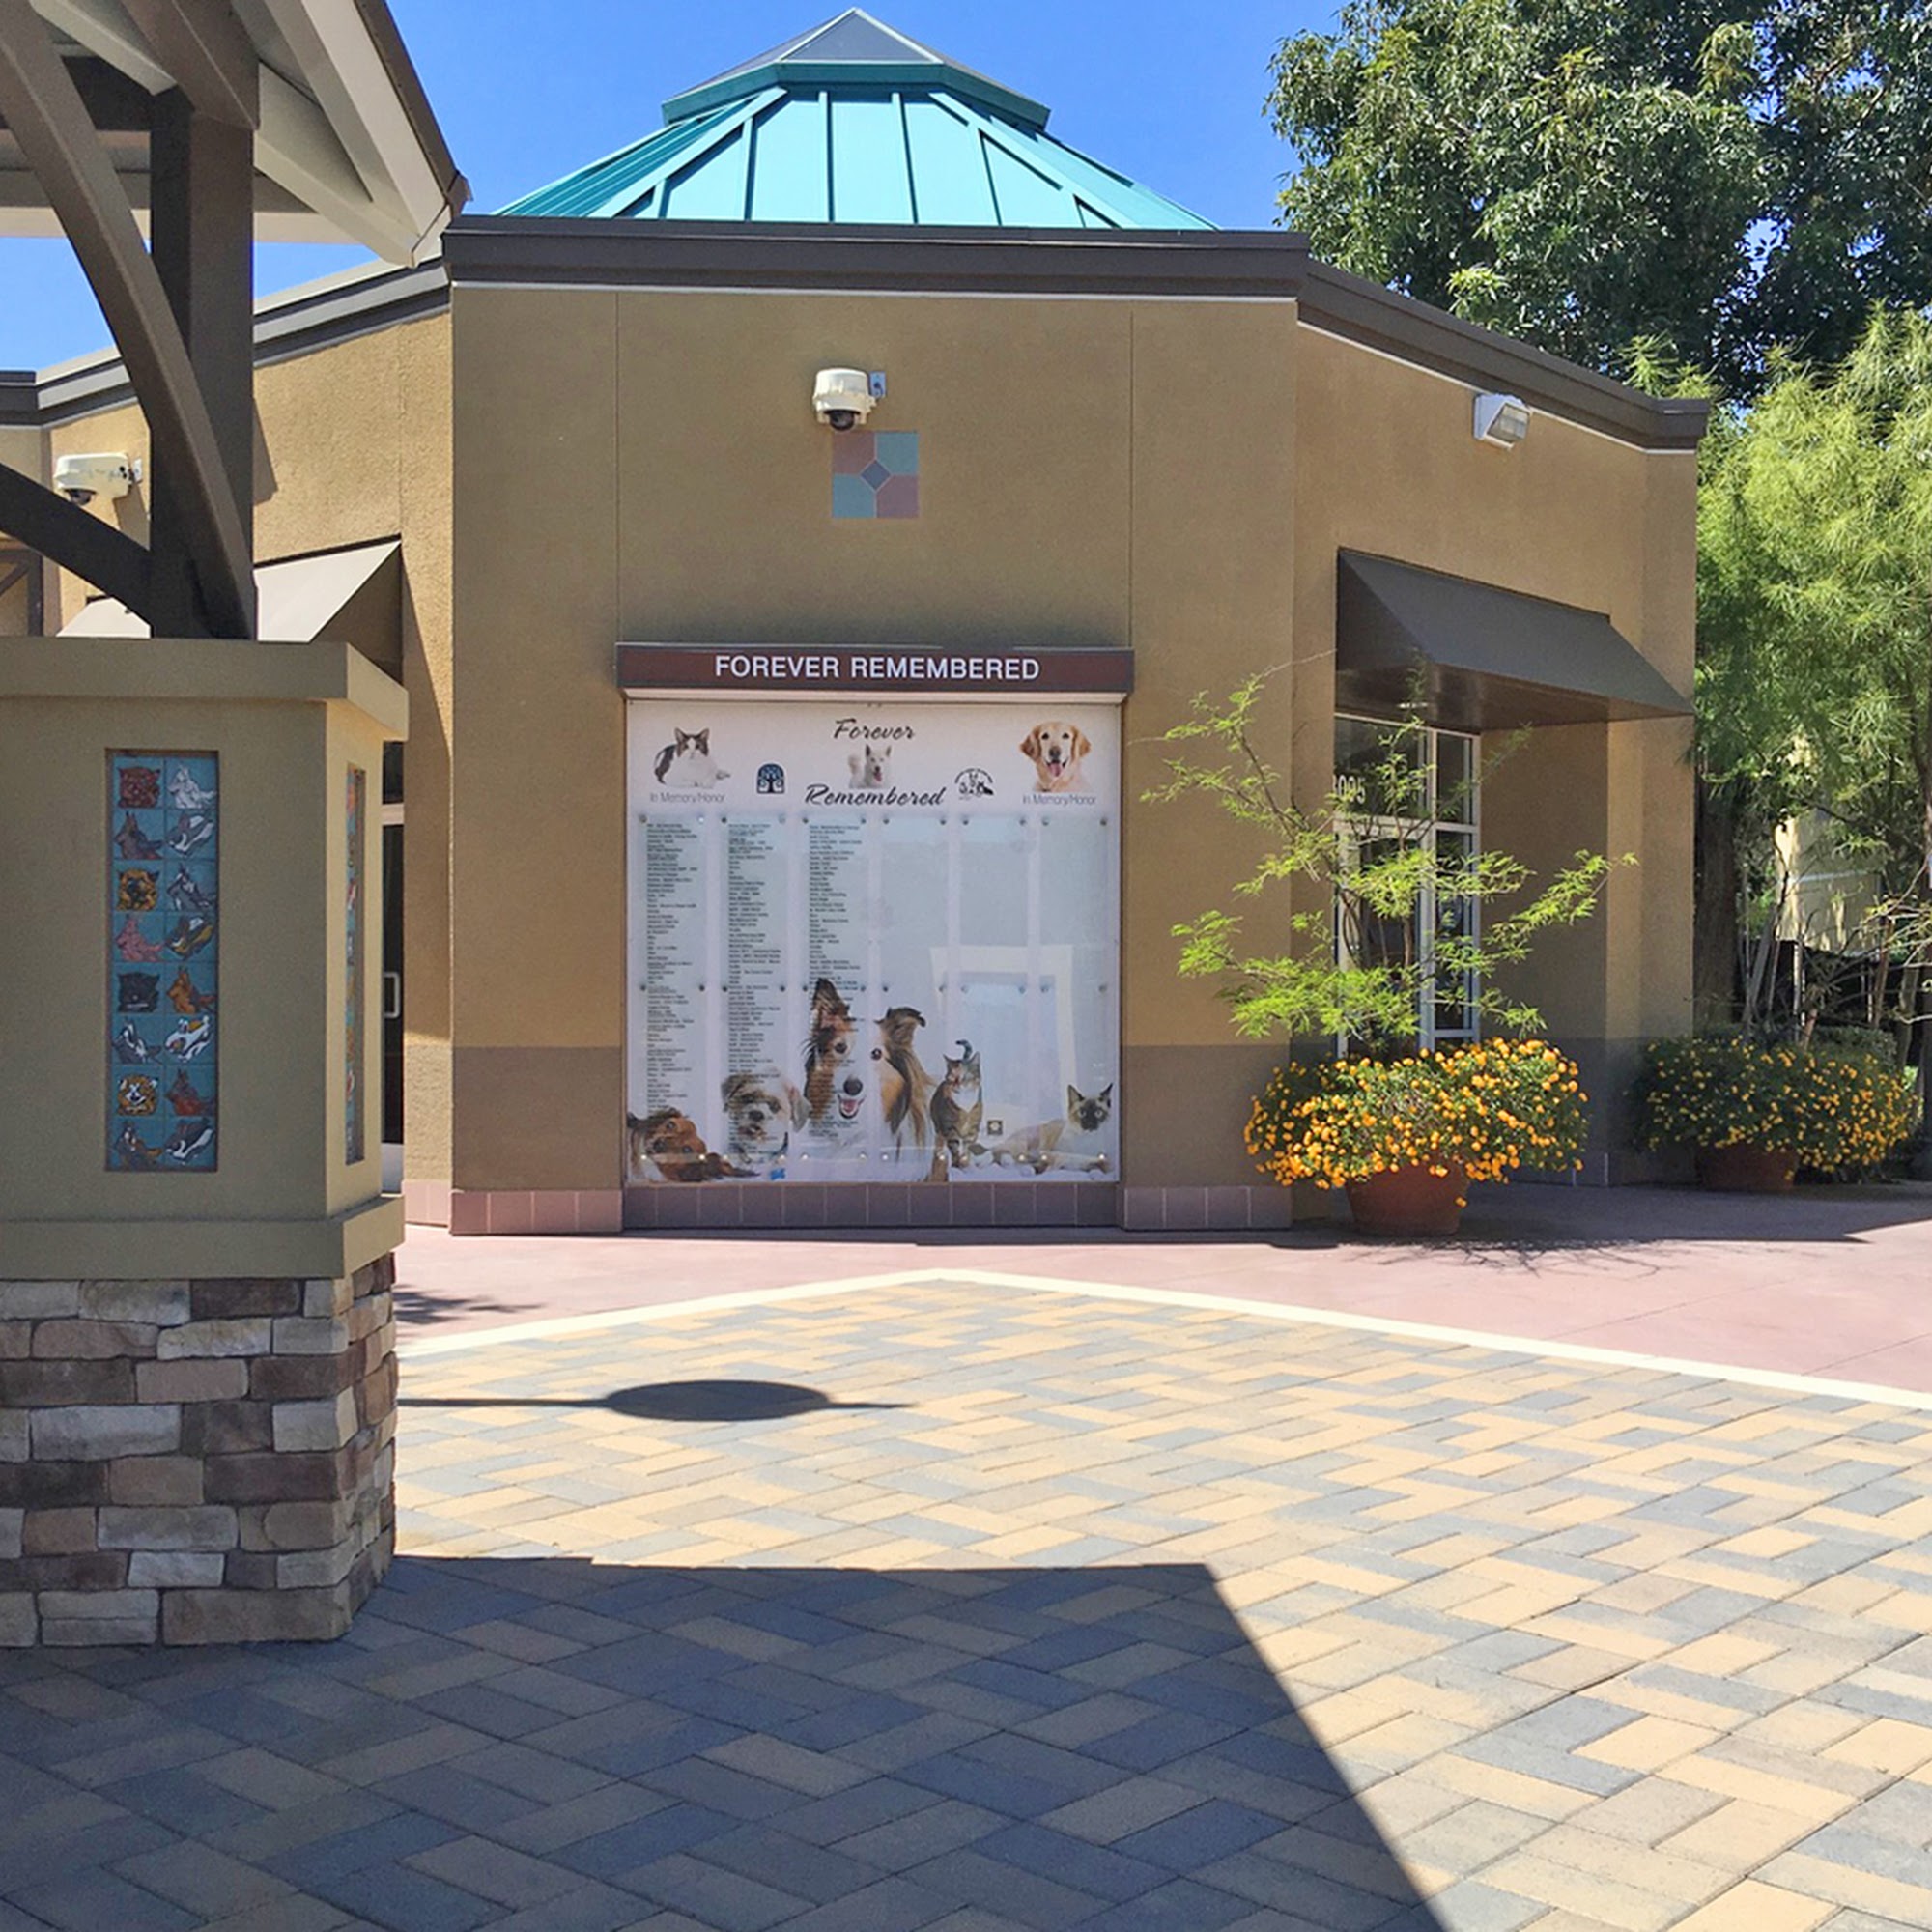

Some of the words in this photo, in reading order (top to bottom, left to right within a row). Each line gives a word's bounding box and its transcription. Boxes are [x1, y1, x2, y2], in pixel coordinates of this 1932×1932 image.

[715, 655, 839, 678] FOREVER
[850, 657, 1040, 680] REMEMBERED
[833, 718, 916, 740] Forever
[804, 783, 947, 806] Remembered
